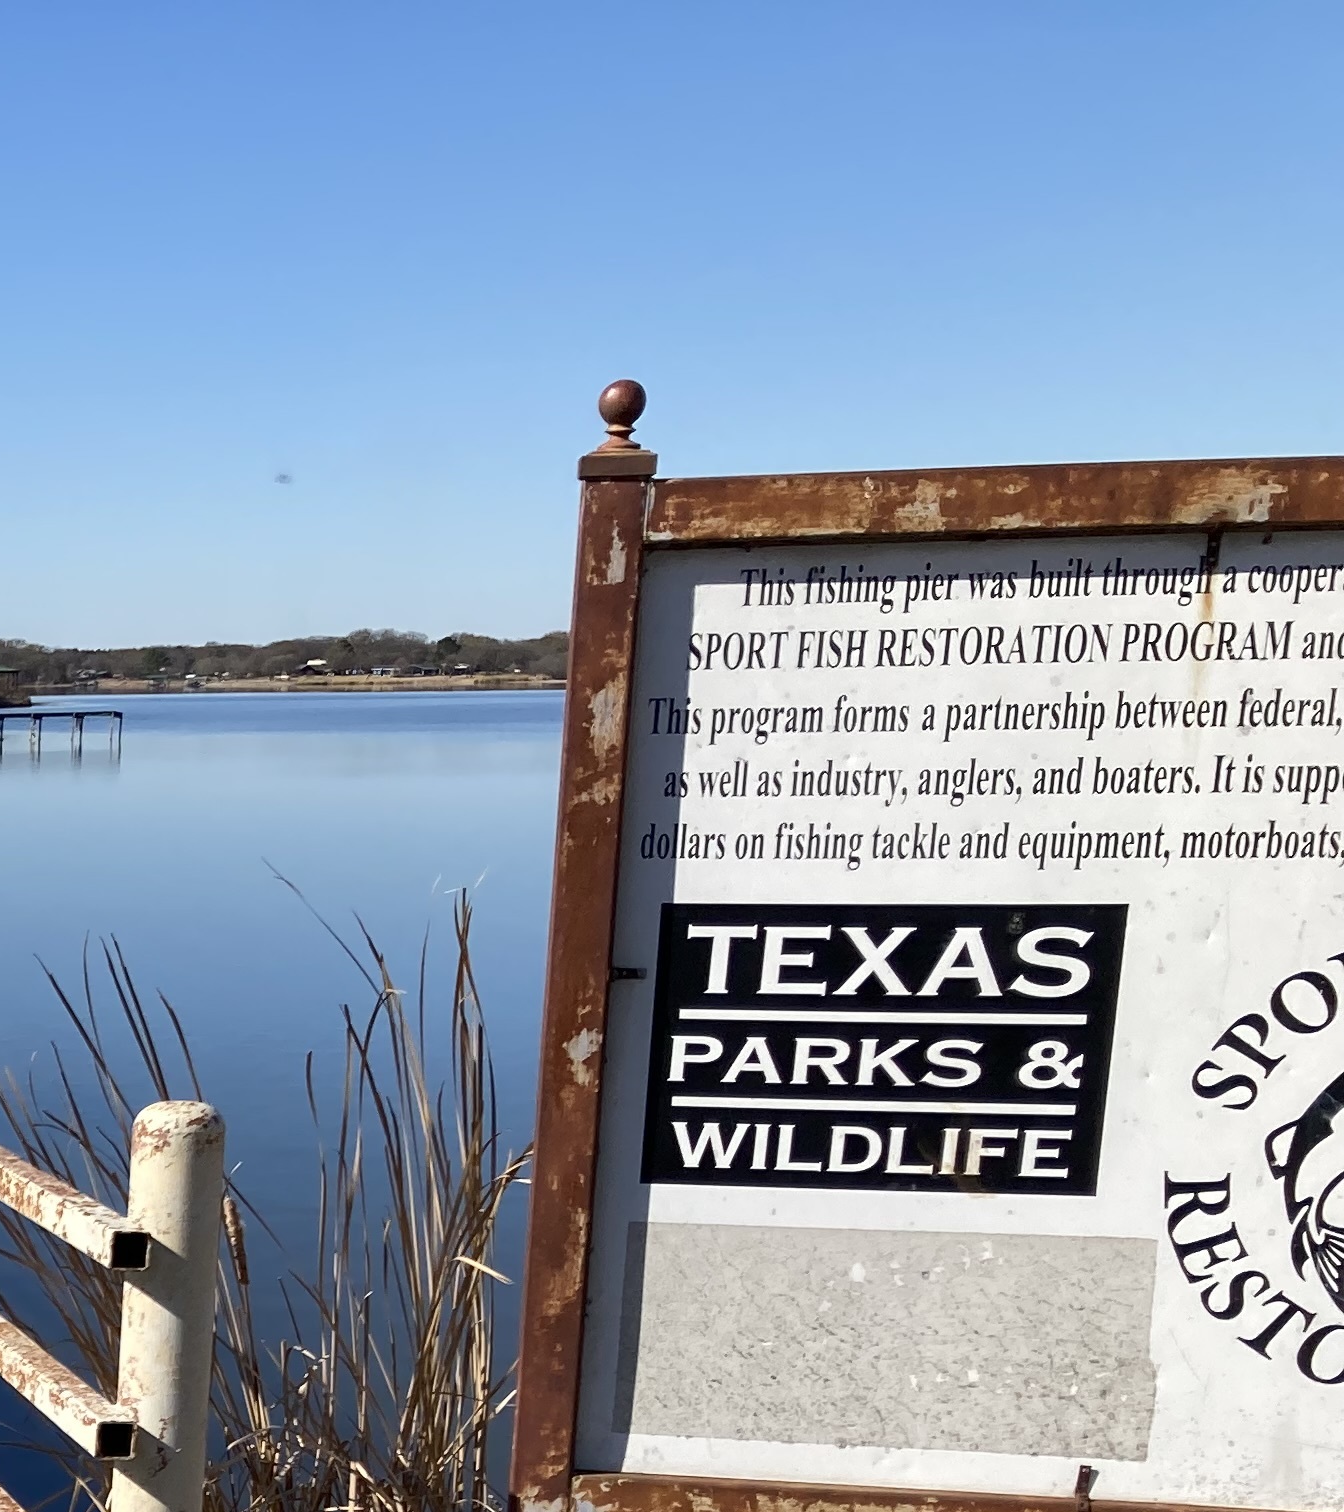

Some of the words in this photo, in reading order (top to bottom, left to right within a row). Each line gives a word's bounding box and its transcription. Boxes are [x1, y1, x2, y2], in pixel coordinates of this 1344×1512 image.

[741, 568, 795, 606] This
[803, 565, 896, 613] fishing
[903, 563, 958, 613] pier
[969, 568, 1017, 599] was
[1029, 558, 1093, 598] built
[1103, 557, 1212, 606] through
[1223, 565, 1236, 594] a
[1248, 564, 1344, 605] cooper
[686, 632, 789, 670] SPORT
[797, 630, 869, 669] FISH
[874, 624, 1113, 667] RESTORATION
[1119, 621, 1294, 662] PROGRAM
[648, 697, 702, 735] This
[709, 707, 823, 745] program
[832, 695, 909, 732] forms
[922, 705, 935, 730] a
[944, 691, 1105, 740] partnership
[1115, 691, 1227, 729] between
[1236, 688, 1342, 735] federal,
[664, 772, 689, 798] as
[699, 760, 748, 797] well
[757, 771, 782, 797] as
[790, 760, 907, 807] industry,
[918, 758, 1021, 807] anglers,
[1033, 757, 1084, 794] and
[1092, 757, 1200, 794] boaters.
[1210, 755, 1236, 793] It
[1242, 754, 1264, 793] is
[1272, 765, 1344, 804] supp
[641, 823, 726, 859] dollars
[735, 834, 764, 859] on
[773, 822, 863, 870] fishing
[873, 822, 950, 859] tackle
[959, 822, 1009, 859] and
[1019, 821, 1170, 870] equipment,
[687, 923, 1095, 997] TEXAS
[1192, 952, 1344, 1110] SPO
[666, 1034, 984, 1089] PARKS
[1017, 1039, 1085, 1090] &
[669, 1121, 1074, 1180] WILDLIFE
